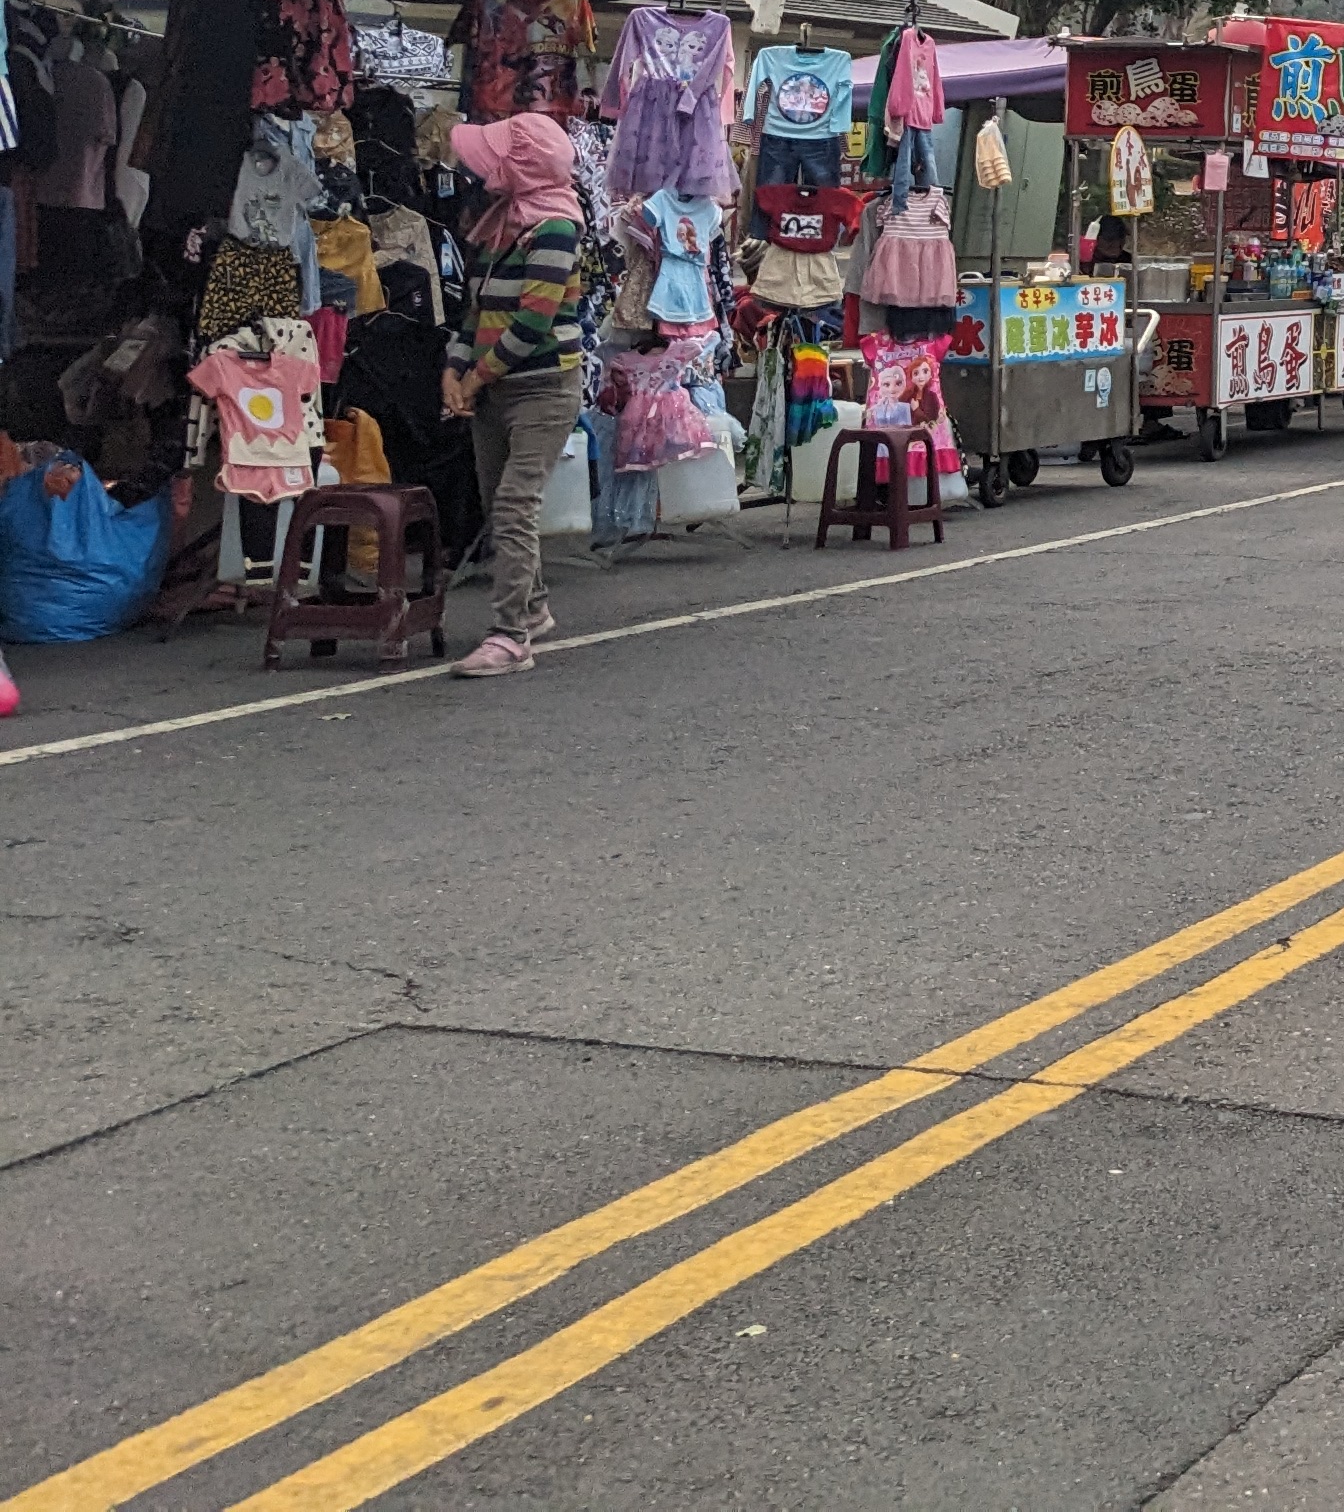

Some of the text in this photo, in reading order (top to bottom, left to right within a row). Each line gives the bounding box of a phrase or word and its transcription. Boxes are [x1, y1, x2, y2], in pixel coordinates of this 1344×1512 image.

[1087, 57, 1201, 105] 煎鳥蛋
[1018, 289, 1056, 308] 古早味
[1080, 287, 1114, 306] 古早味
[1075, 311, 1119, 349] 芋冰
[1225, 321, 1309, 398] 煎鳥蛋
